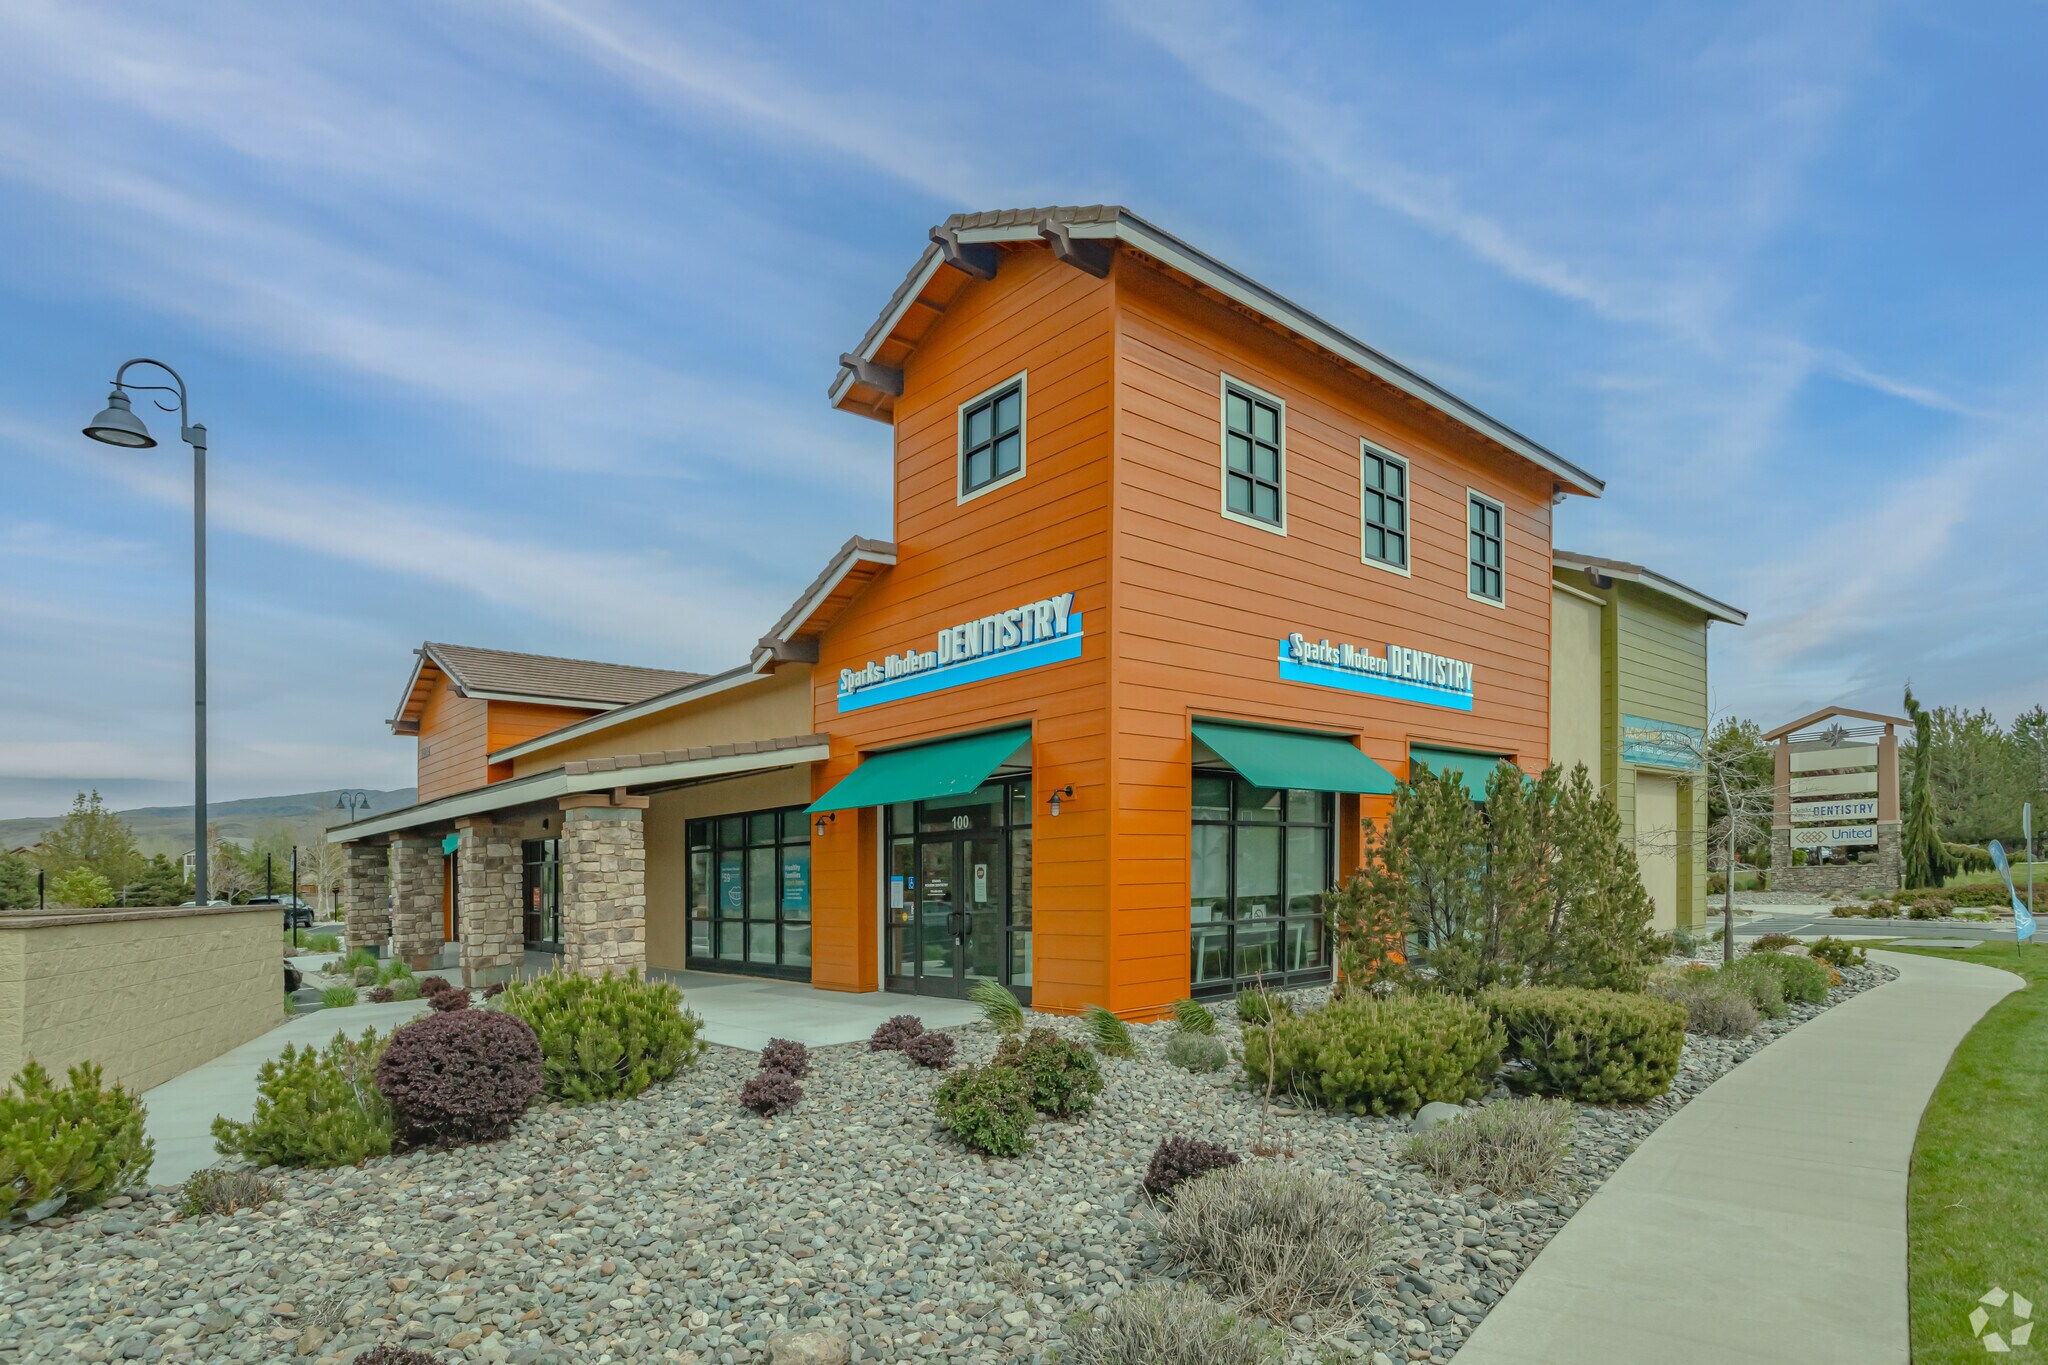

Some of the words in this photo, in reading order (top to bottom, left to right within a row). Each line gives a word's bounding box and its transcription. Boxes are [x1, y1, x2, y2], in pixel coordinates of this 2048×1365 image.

[840, 661, 886, 693] Sparks
[884, 650, 938, 679] Modern
[937, 591, 1076, 666] DENTISTRY
[1288, 632, 1340, 665] Sparks
[1339, 643, 1388, 675] Modern
[1386, 643, 1473, 691] DENTISTRY
[1813, 803, 1874, 817] DENTISTRY
[951, 815, 969, 830] 100
[1831, 828, 1873, 840] United
